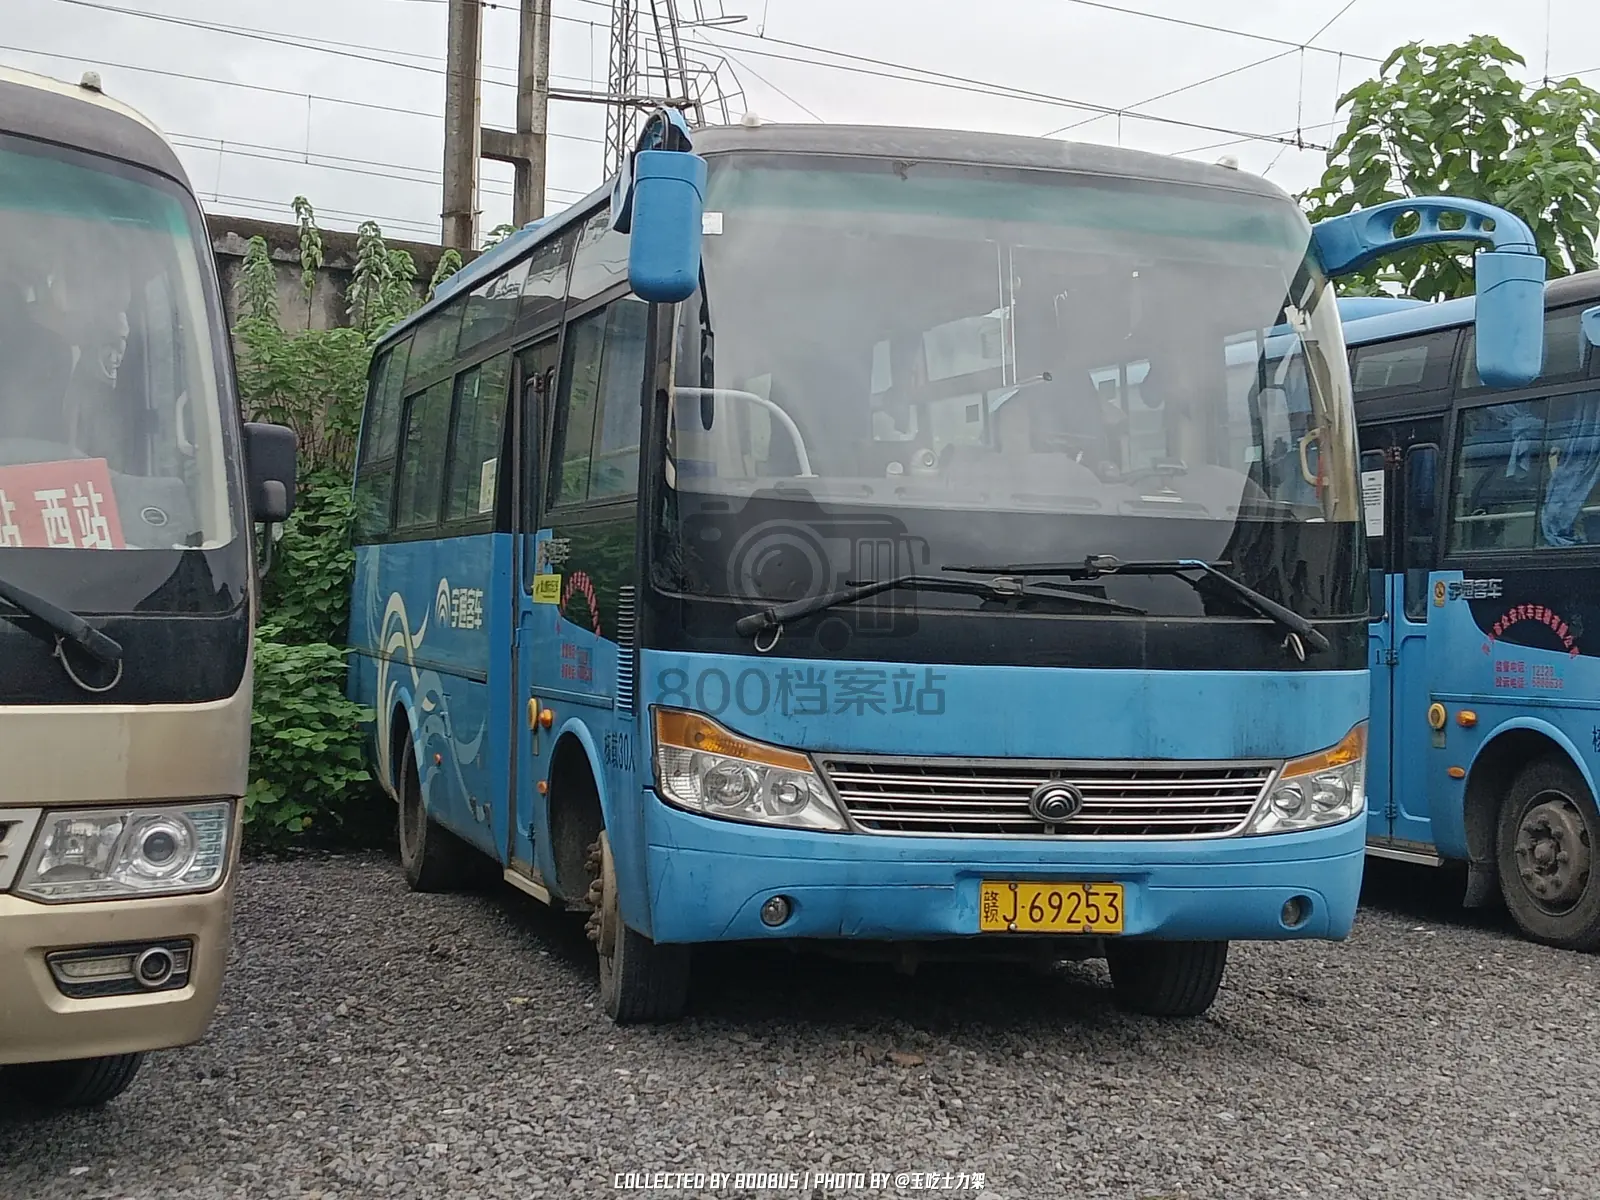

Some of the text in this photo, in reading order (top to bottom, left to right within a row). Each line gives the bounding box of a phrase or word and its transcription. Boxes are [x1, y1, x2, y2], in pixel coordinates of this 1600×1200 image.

[33, 481, 113, 549] 西站
[451, 588, 484, 630] 宇通客车
